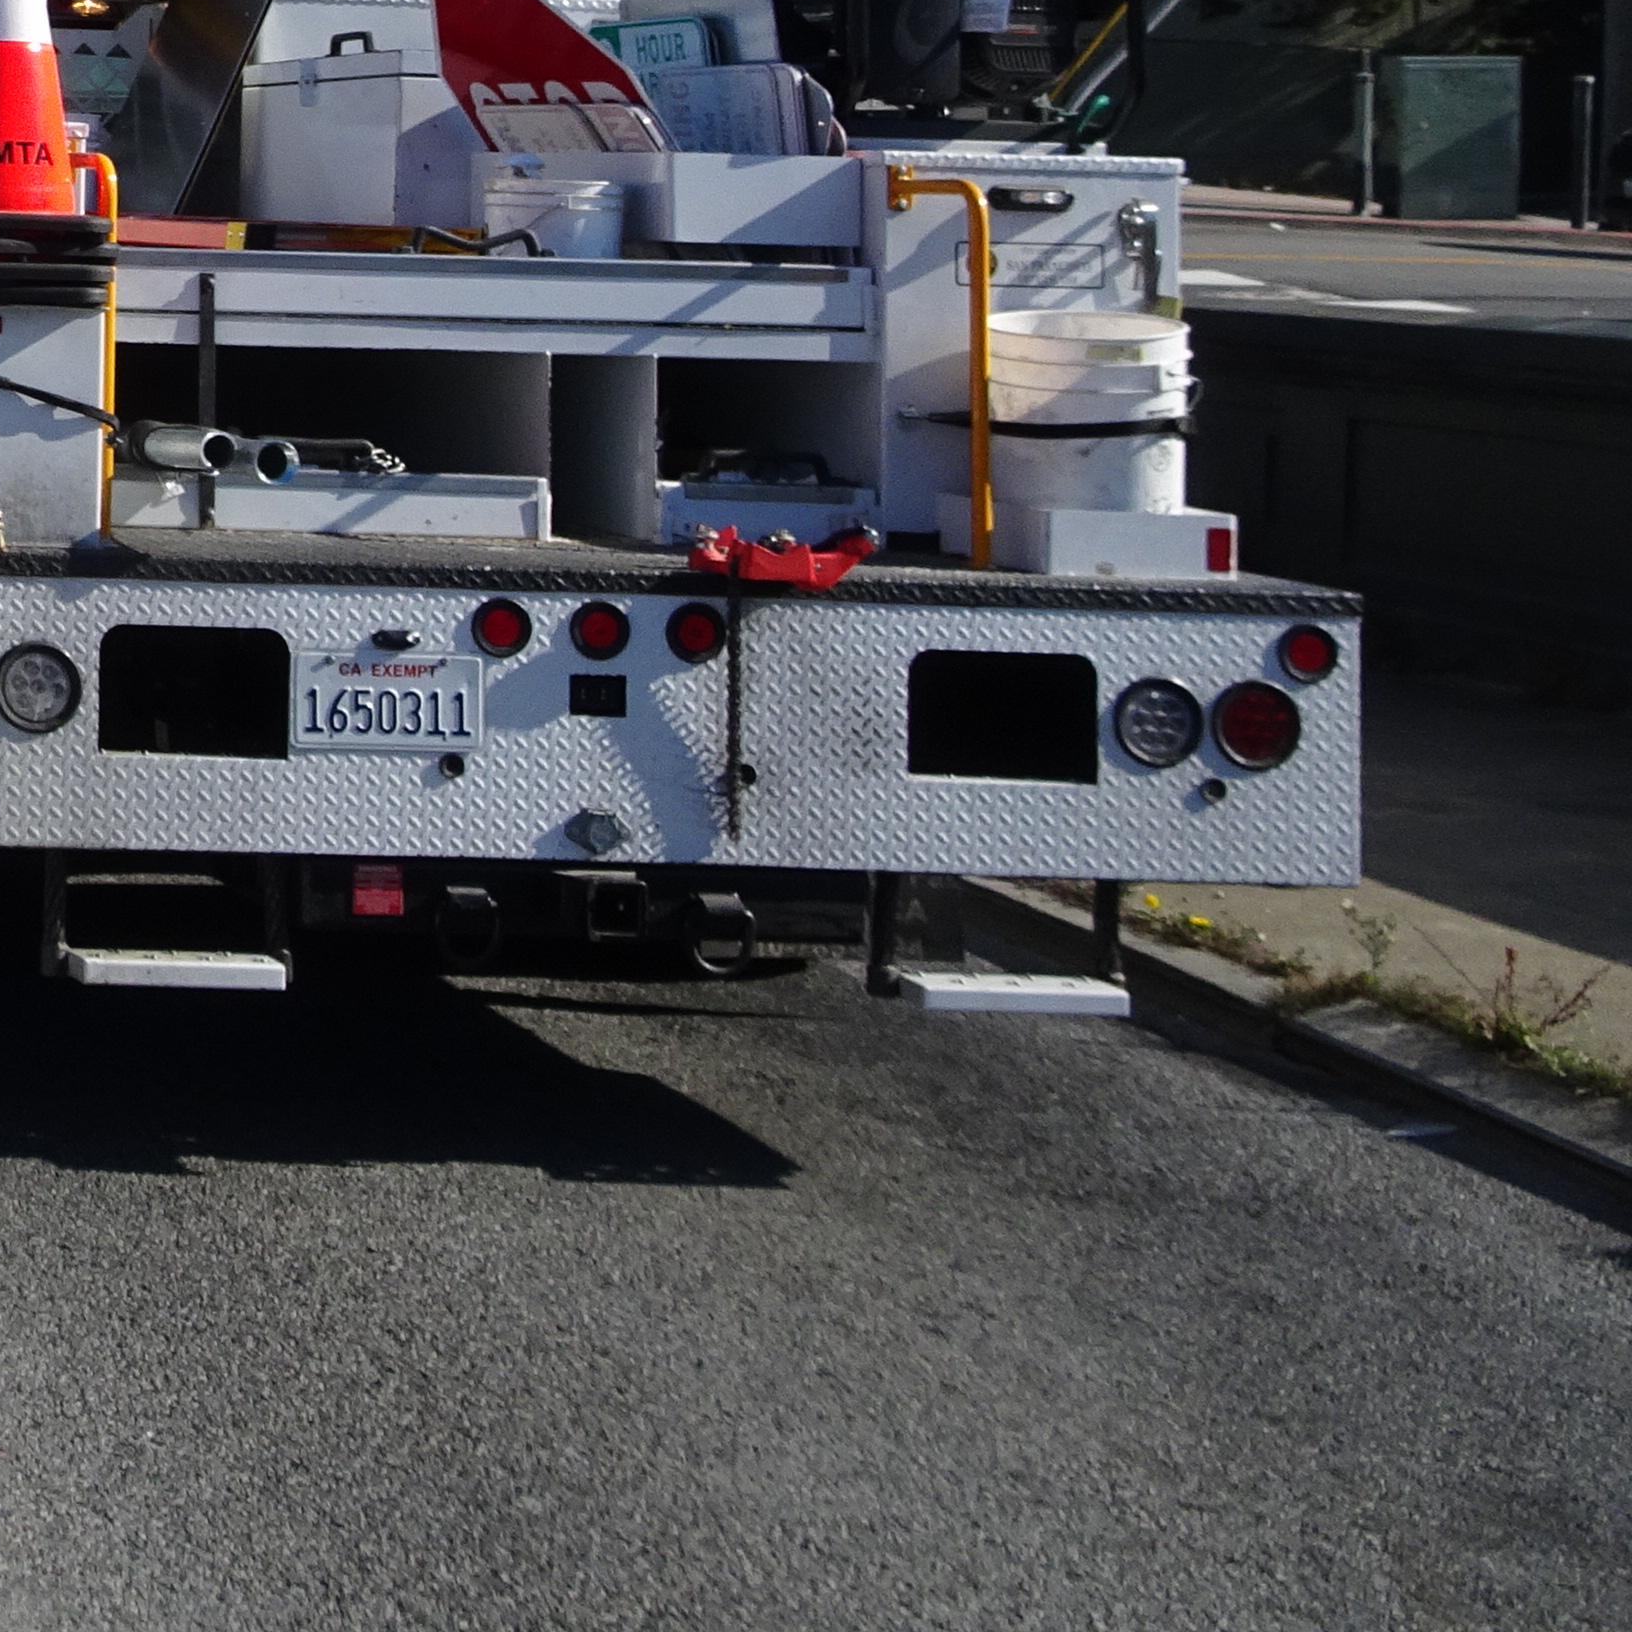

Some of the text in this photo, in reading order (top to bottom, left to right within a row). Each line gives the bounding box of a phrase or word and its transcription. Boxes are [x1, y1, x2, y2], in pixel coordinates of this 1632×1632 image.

[636, 32, 686, 64] HOUR
[338, 663, 438, 678] CA EXEMPT
[304, 688, 472, 737] 1650311
